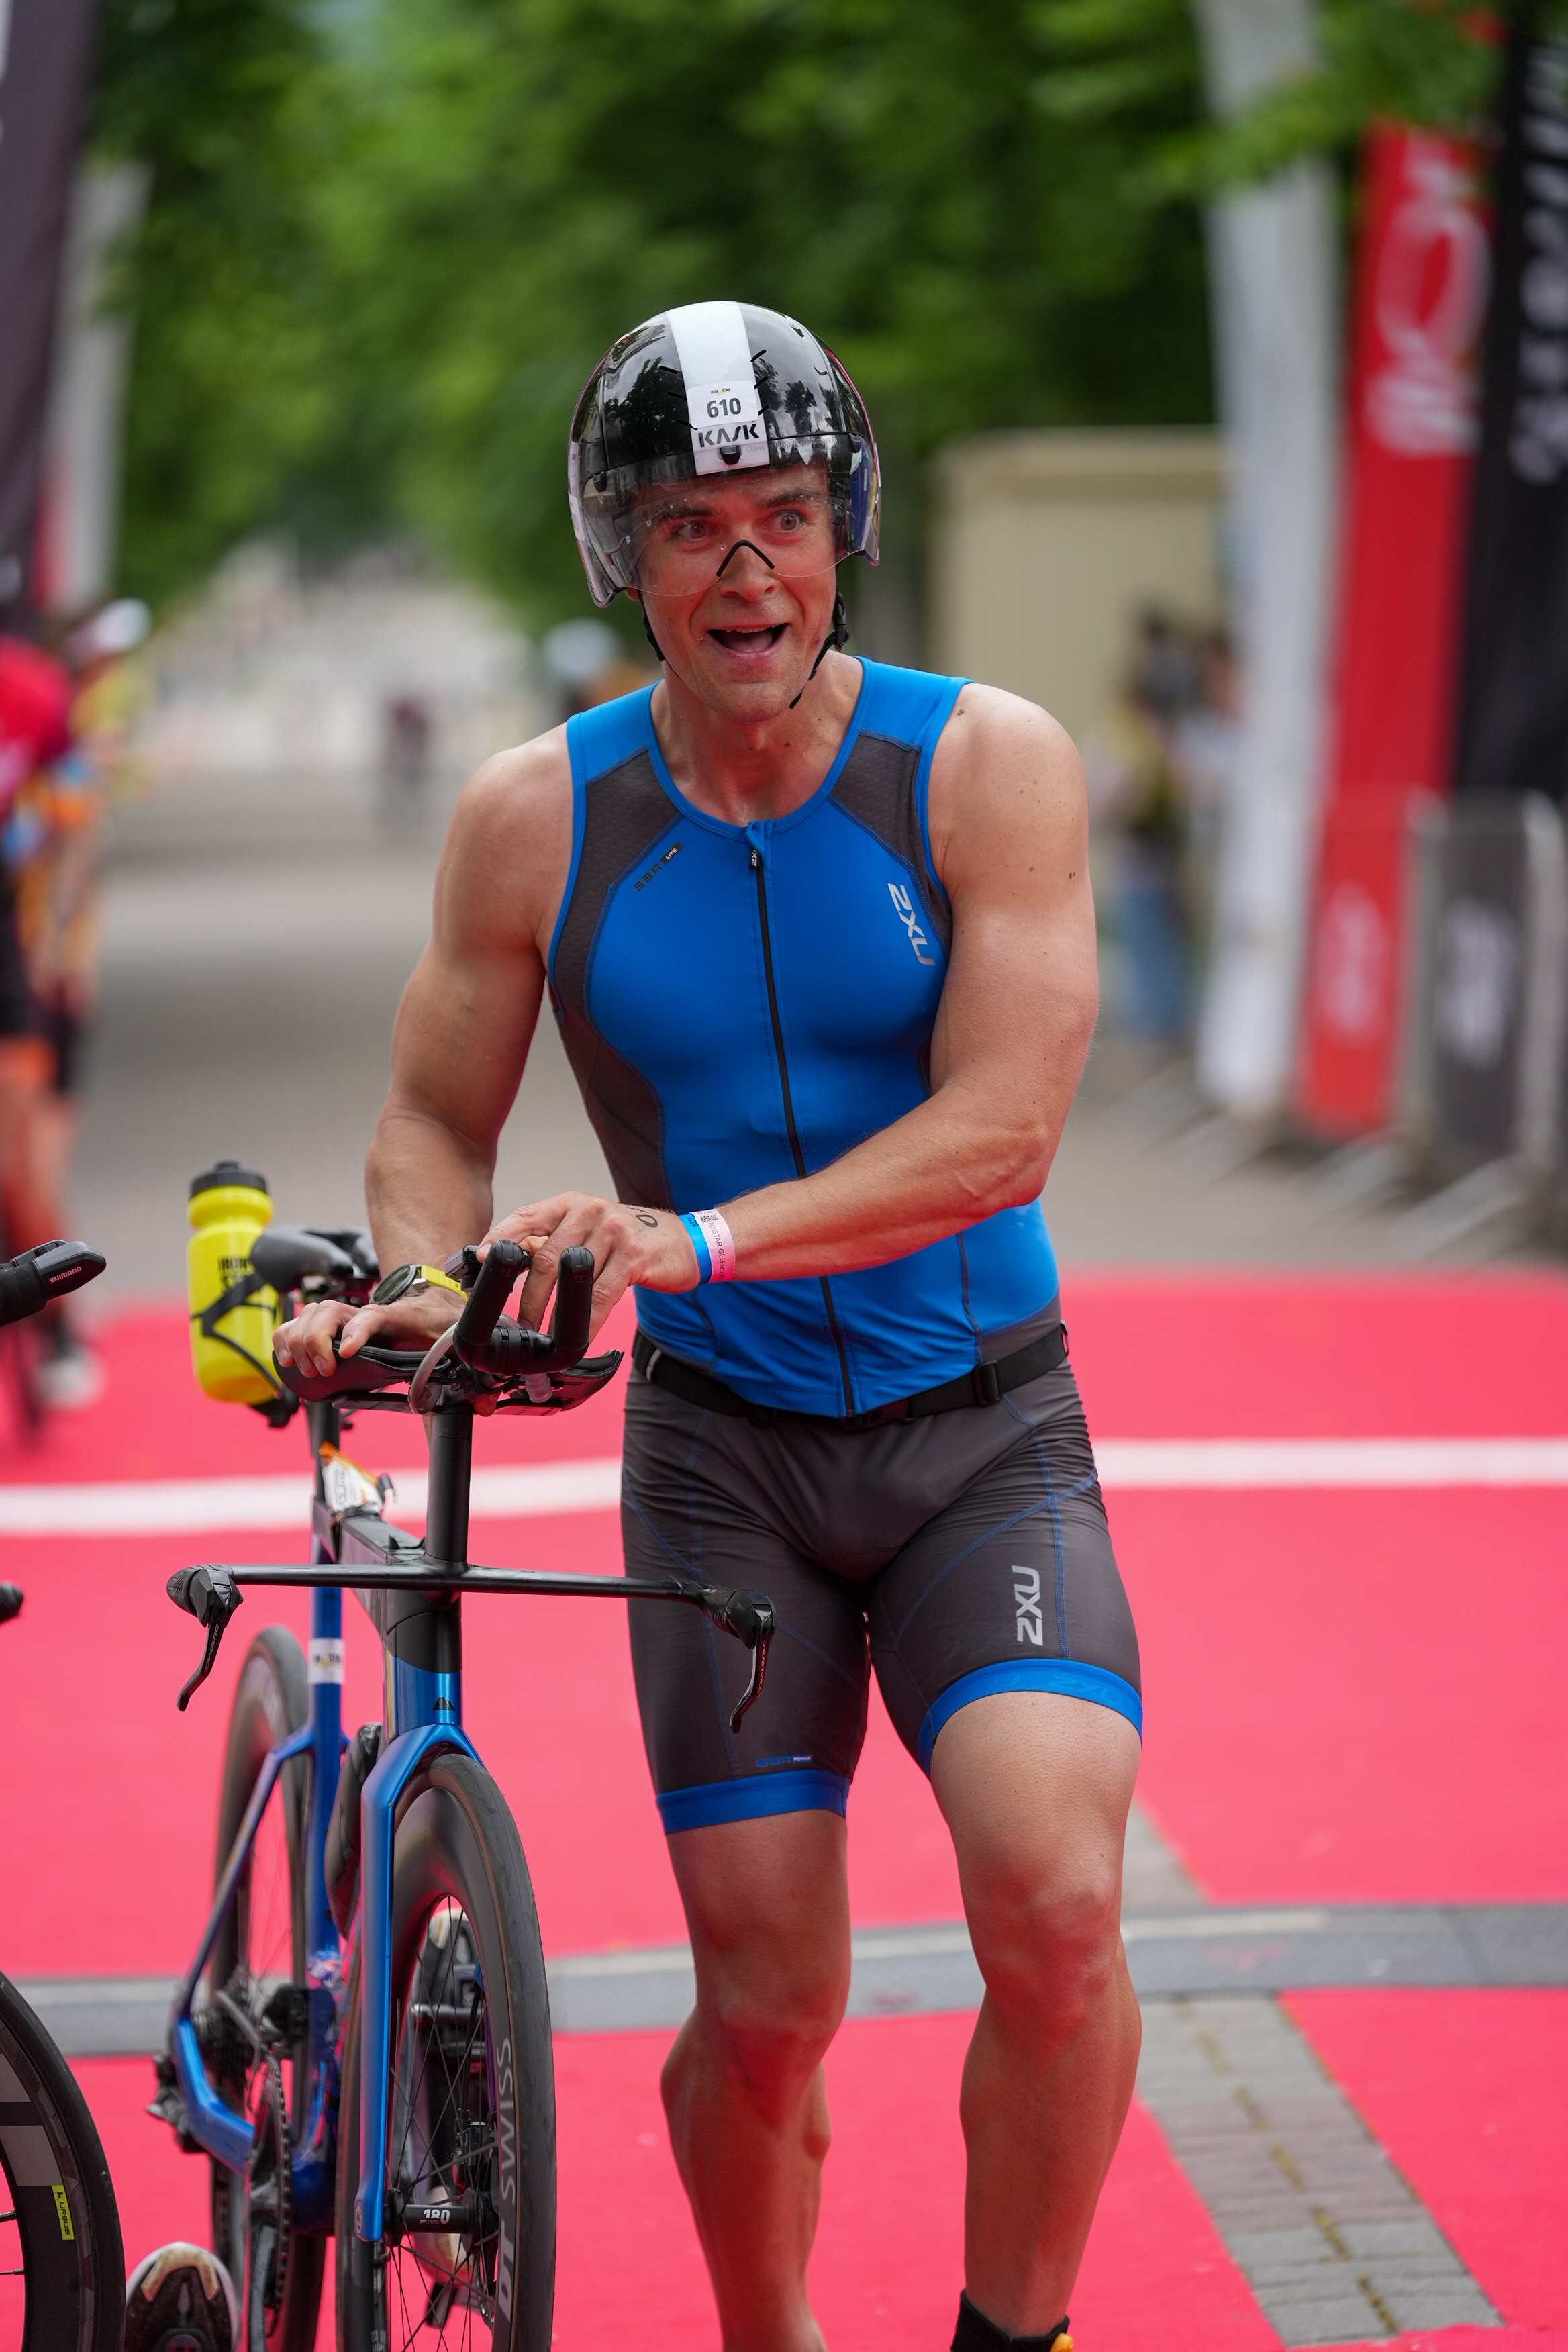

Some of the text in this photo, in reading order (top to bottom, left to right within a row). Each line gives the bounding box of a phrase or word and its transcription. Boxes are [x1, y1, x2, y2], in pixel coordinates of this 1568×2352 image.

[707, 397, 742, 418] 610
[698, 423, 760, 448] KASK
[746, 444, 766, 453] CRONO
[634, 848, 678, 892] SBR LITE
[887, 883, 936, 965] 2XU
[49, 1266, 82, 1283] SHIMANO
[1012, 1565, 1043, 1646] 2XU
[497, 2037, 516, 2324] DT SWISS
[59, 2202, 70, 2235] URSUS
[423, 2208, 450, 2224] 180
